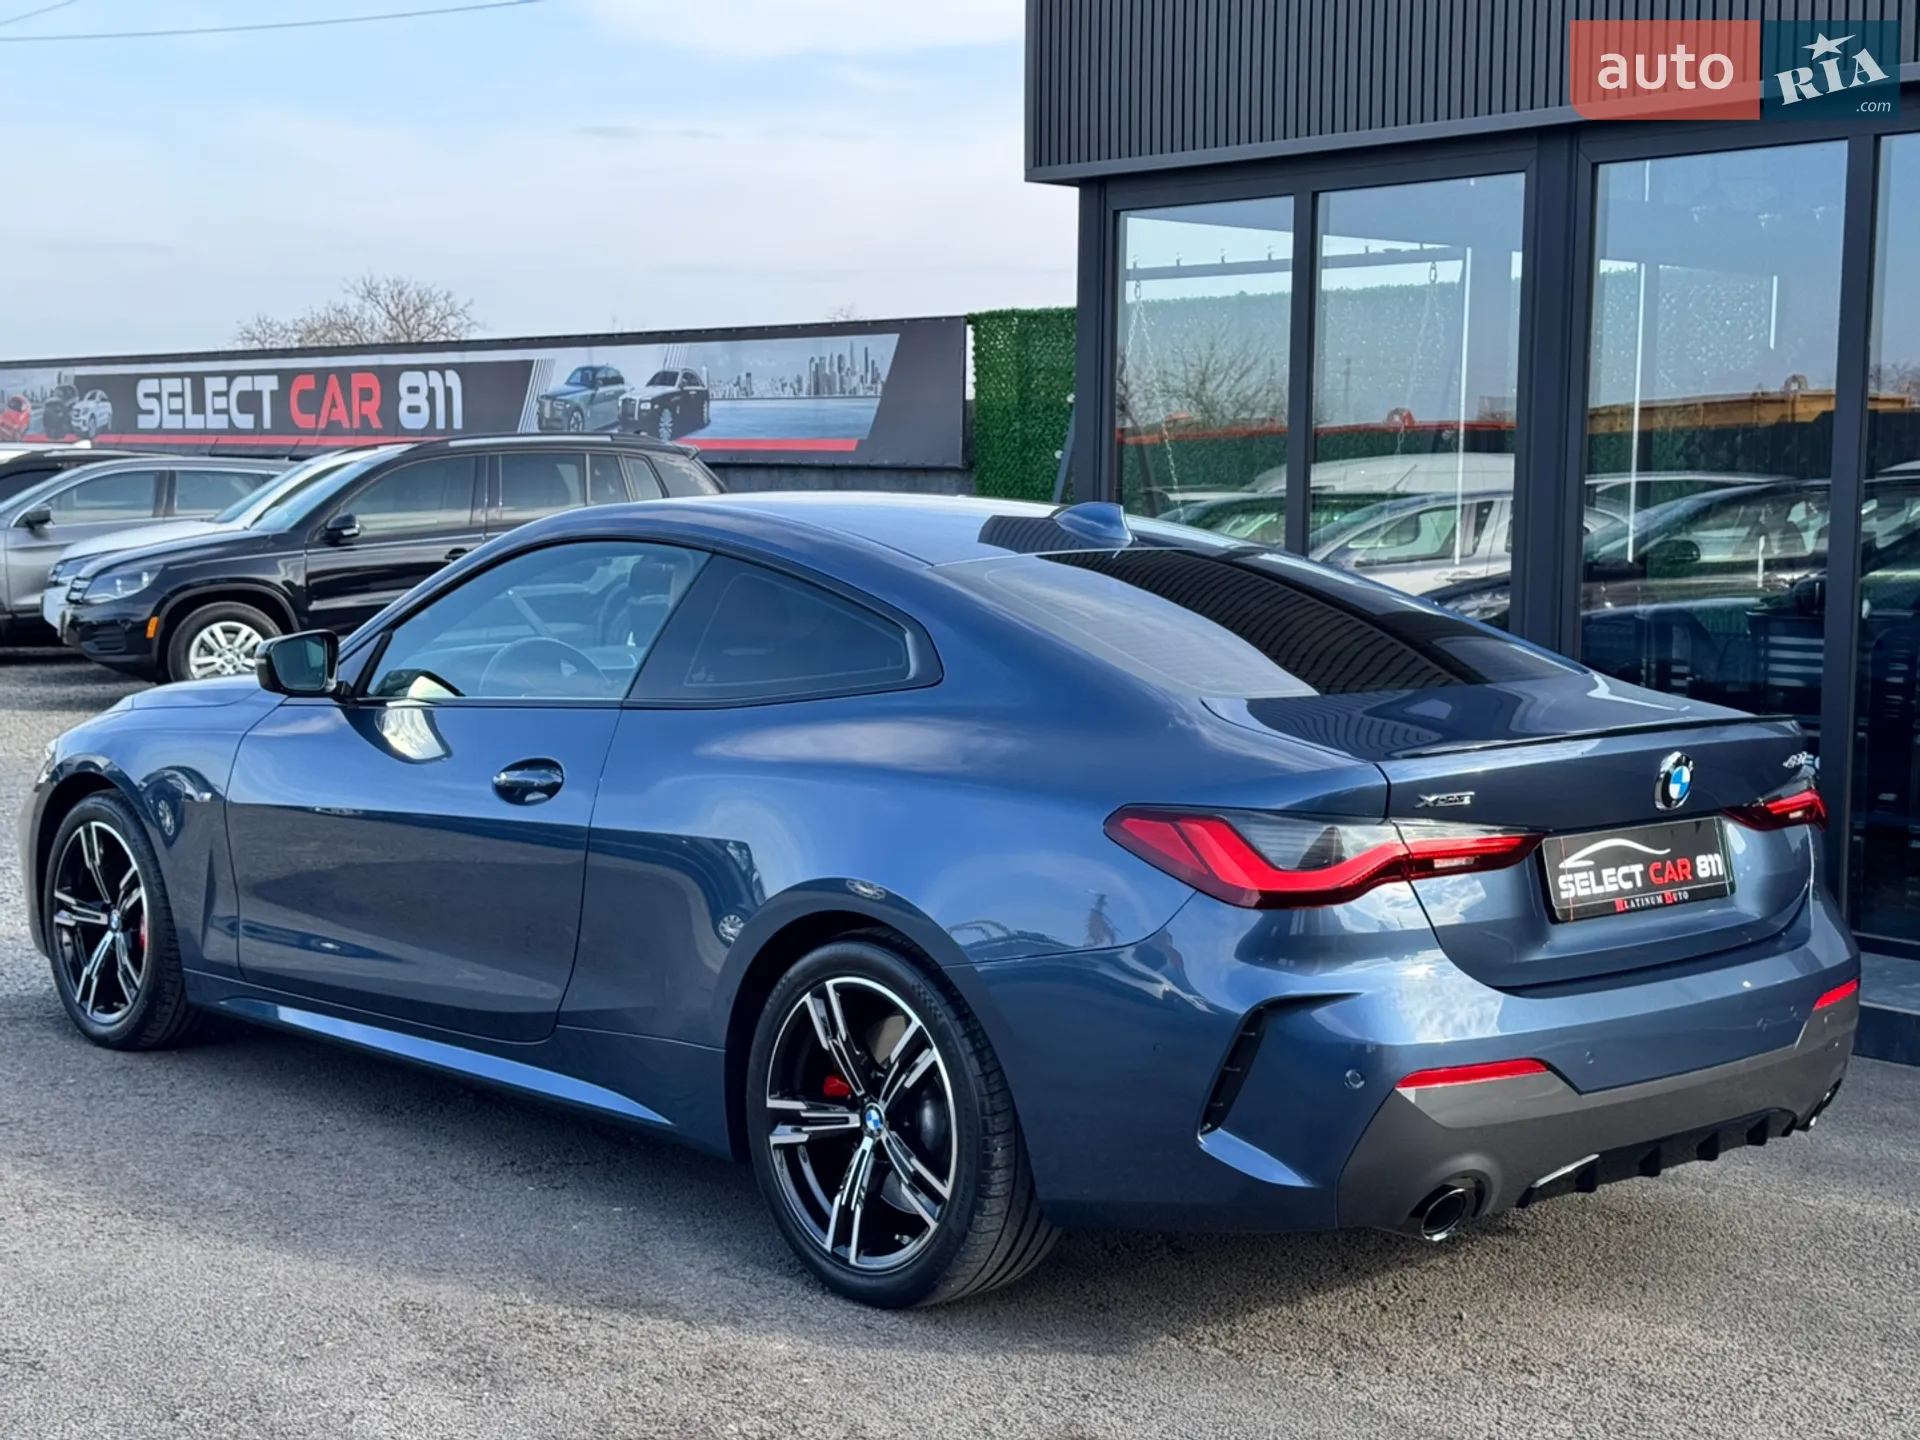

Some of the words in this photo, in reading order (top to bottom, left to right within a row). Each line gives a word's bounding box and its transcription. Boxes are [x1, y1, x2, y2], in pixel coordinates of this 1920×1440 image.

[135, 375, 279, 430] SELECT
[289, 371, 383, 430] CAR
[398, 369, 463, 430] 811
[1557, 863, 1644, 900] SELECT
[1648, 857, 1693, 885] CAR
[1695, 853, 1724, 878] 811
